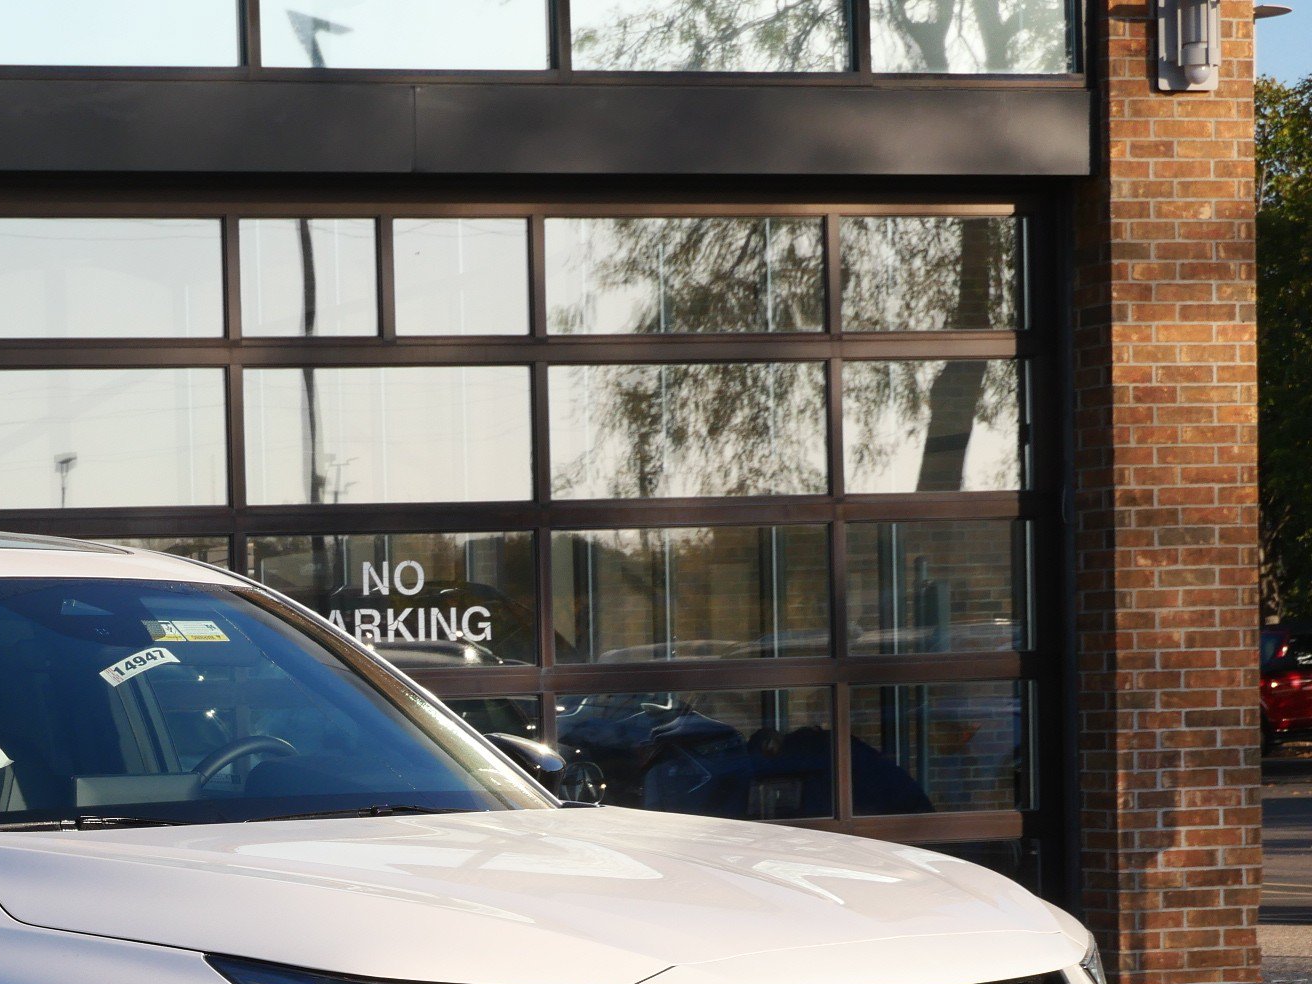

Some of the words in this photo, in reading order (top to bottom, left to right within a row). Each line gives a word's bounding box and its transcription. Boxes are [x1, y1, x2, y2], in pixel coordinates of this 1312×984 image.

[362, 560, 425, 596] NO
[327, 605, 492, 643] ARKING
[113, 649, 166, 677] 14947
